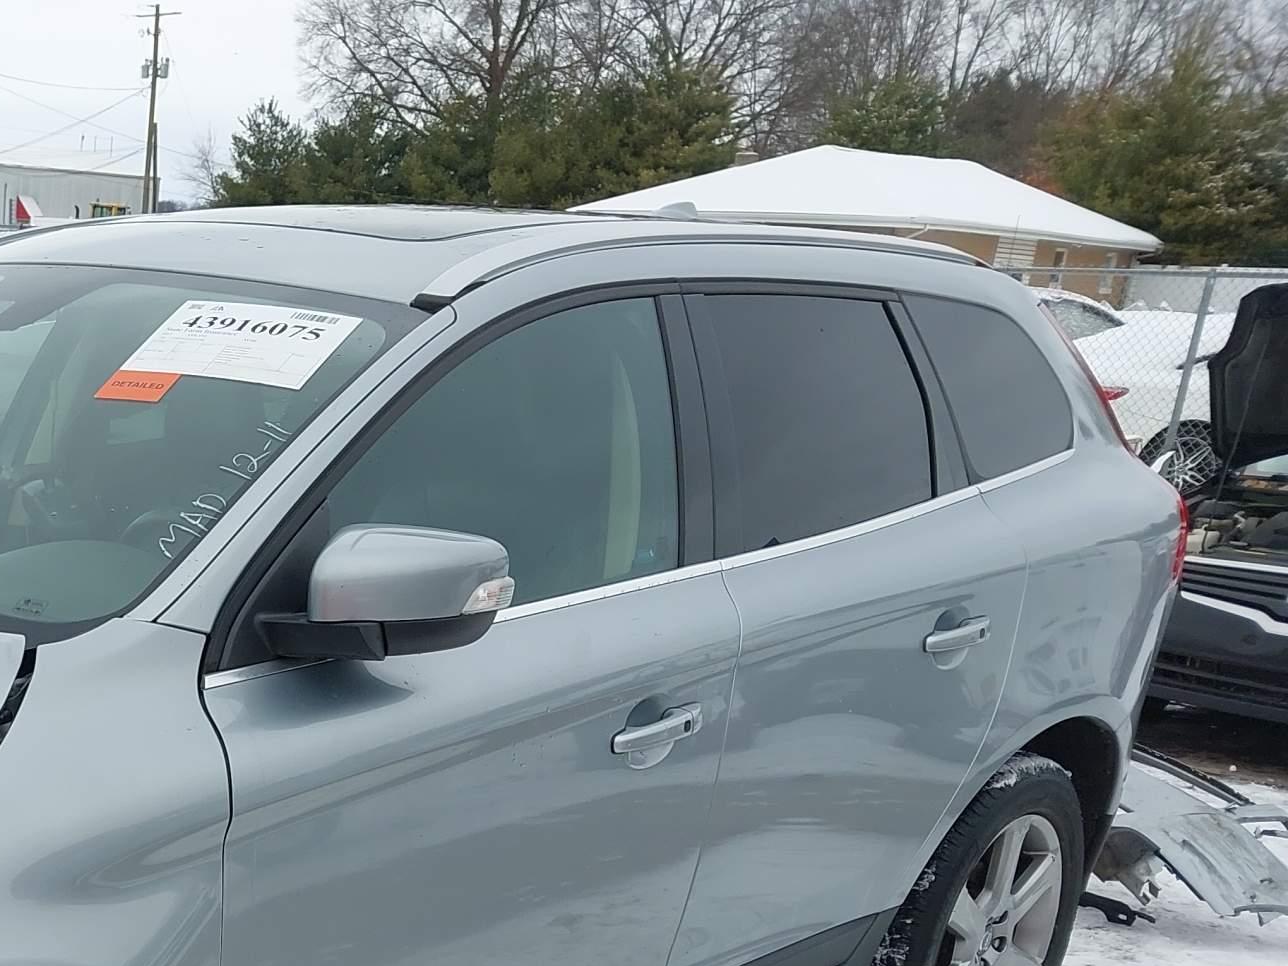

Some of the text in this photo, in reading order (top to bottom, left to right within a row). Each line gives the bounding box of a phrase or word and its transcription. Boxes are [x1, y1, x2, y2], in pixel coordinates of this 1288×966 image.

[182, 315, 327, 341] 43916075
[111, 380, 165, 390] DETAILED
[158, 493, 227, 560] MAD
